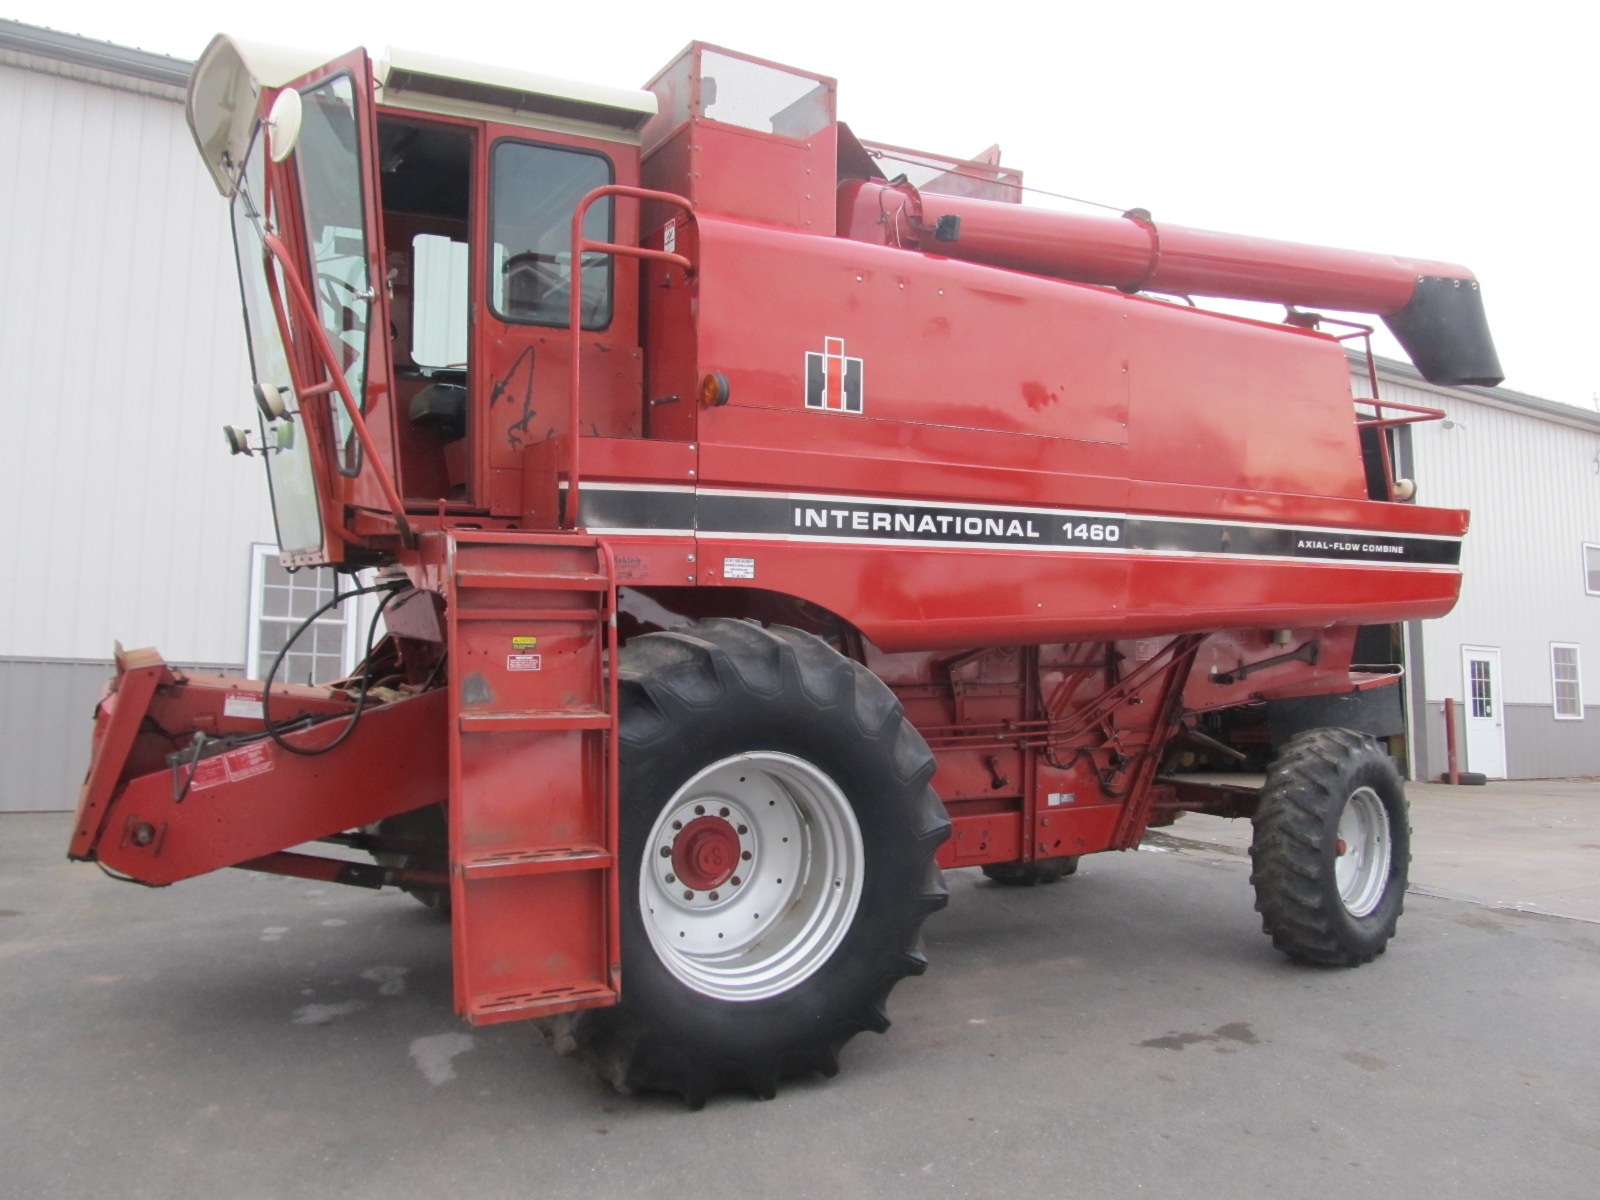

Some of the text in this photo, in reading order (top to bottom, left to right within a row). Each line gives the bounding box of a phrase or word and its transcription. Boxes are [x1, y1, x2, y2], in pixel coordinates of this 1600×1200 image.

[794, 507, 1120, 542] INTERNATIONAL 1460
[1297, 540, 1404, 554] AXIAL-FLOW COMBINE
